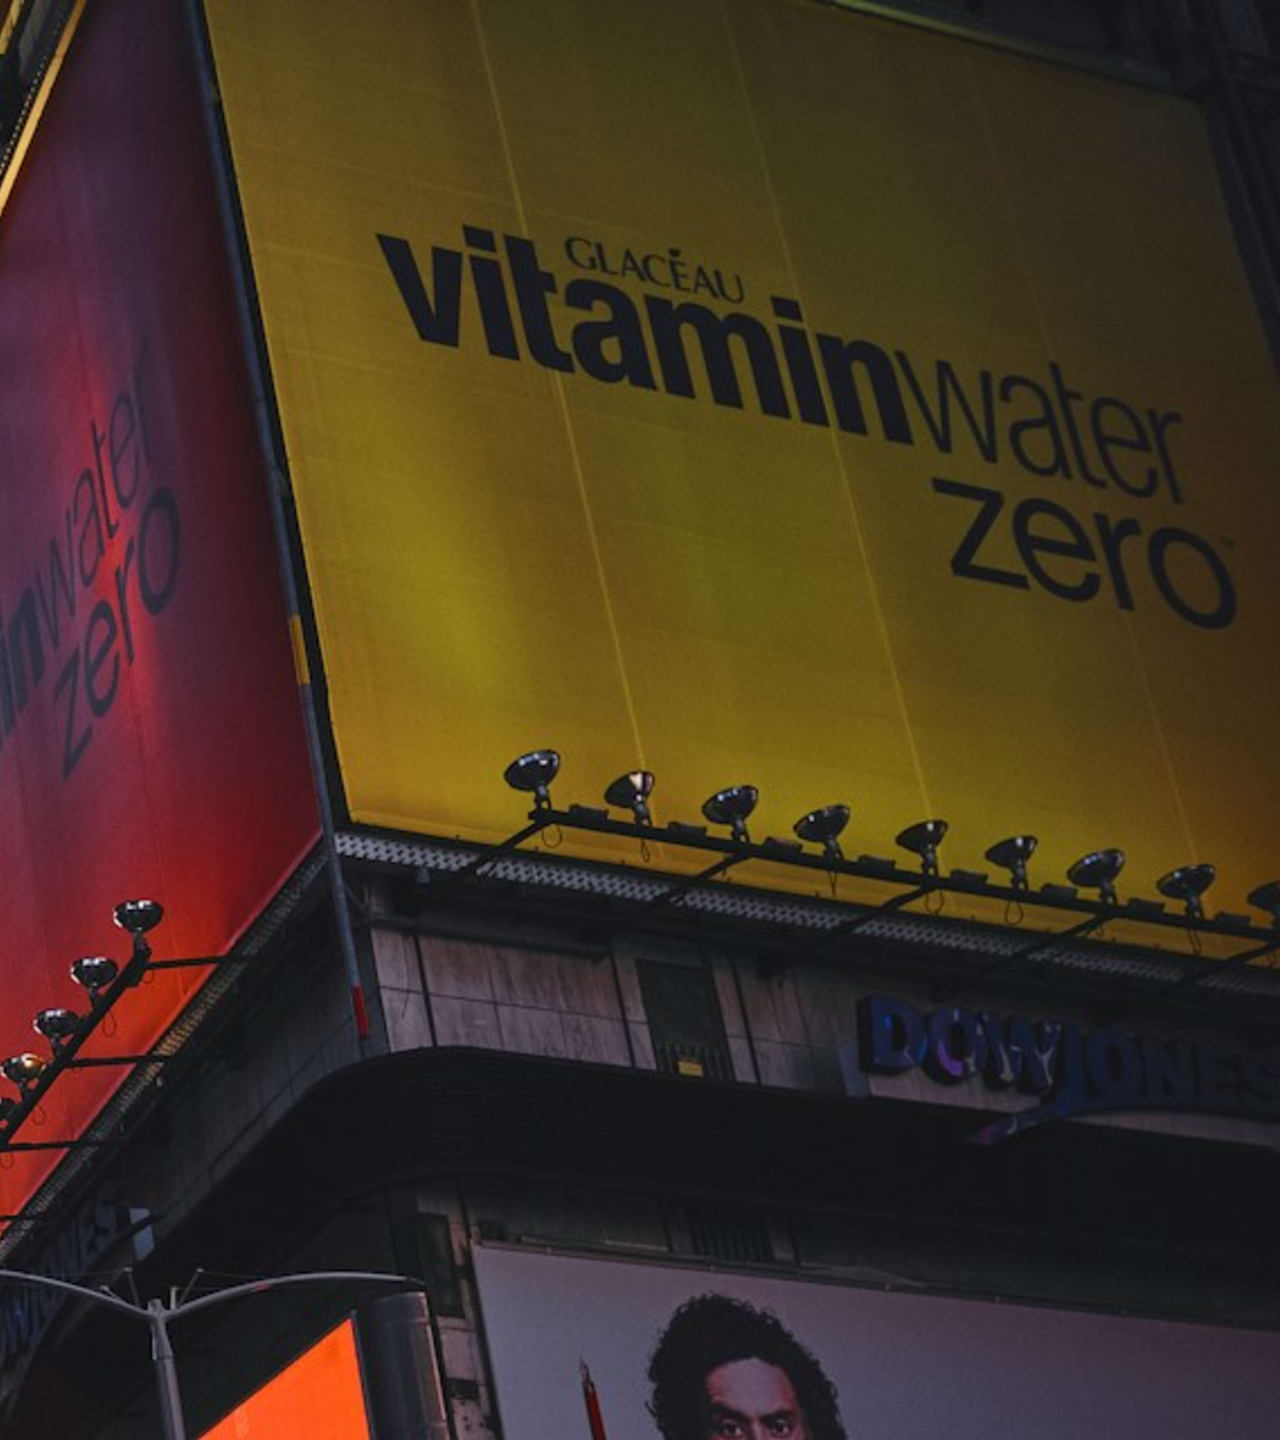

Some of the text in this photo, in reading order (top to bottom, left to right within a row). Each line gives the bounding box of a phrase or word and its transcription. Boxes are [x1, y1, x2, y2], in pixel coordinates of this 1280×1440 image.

[564, 236, 745, 305] GLACÉAU
[930, 477, 1238, 631] zero
[53, 486, 181, 782] zero
